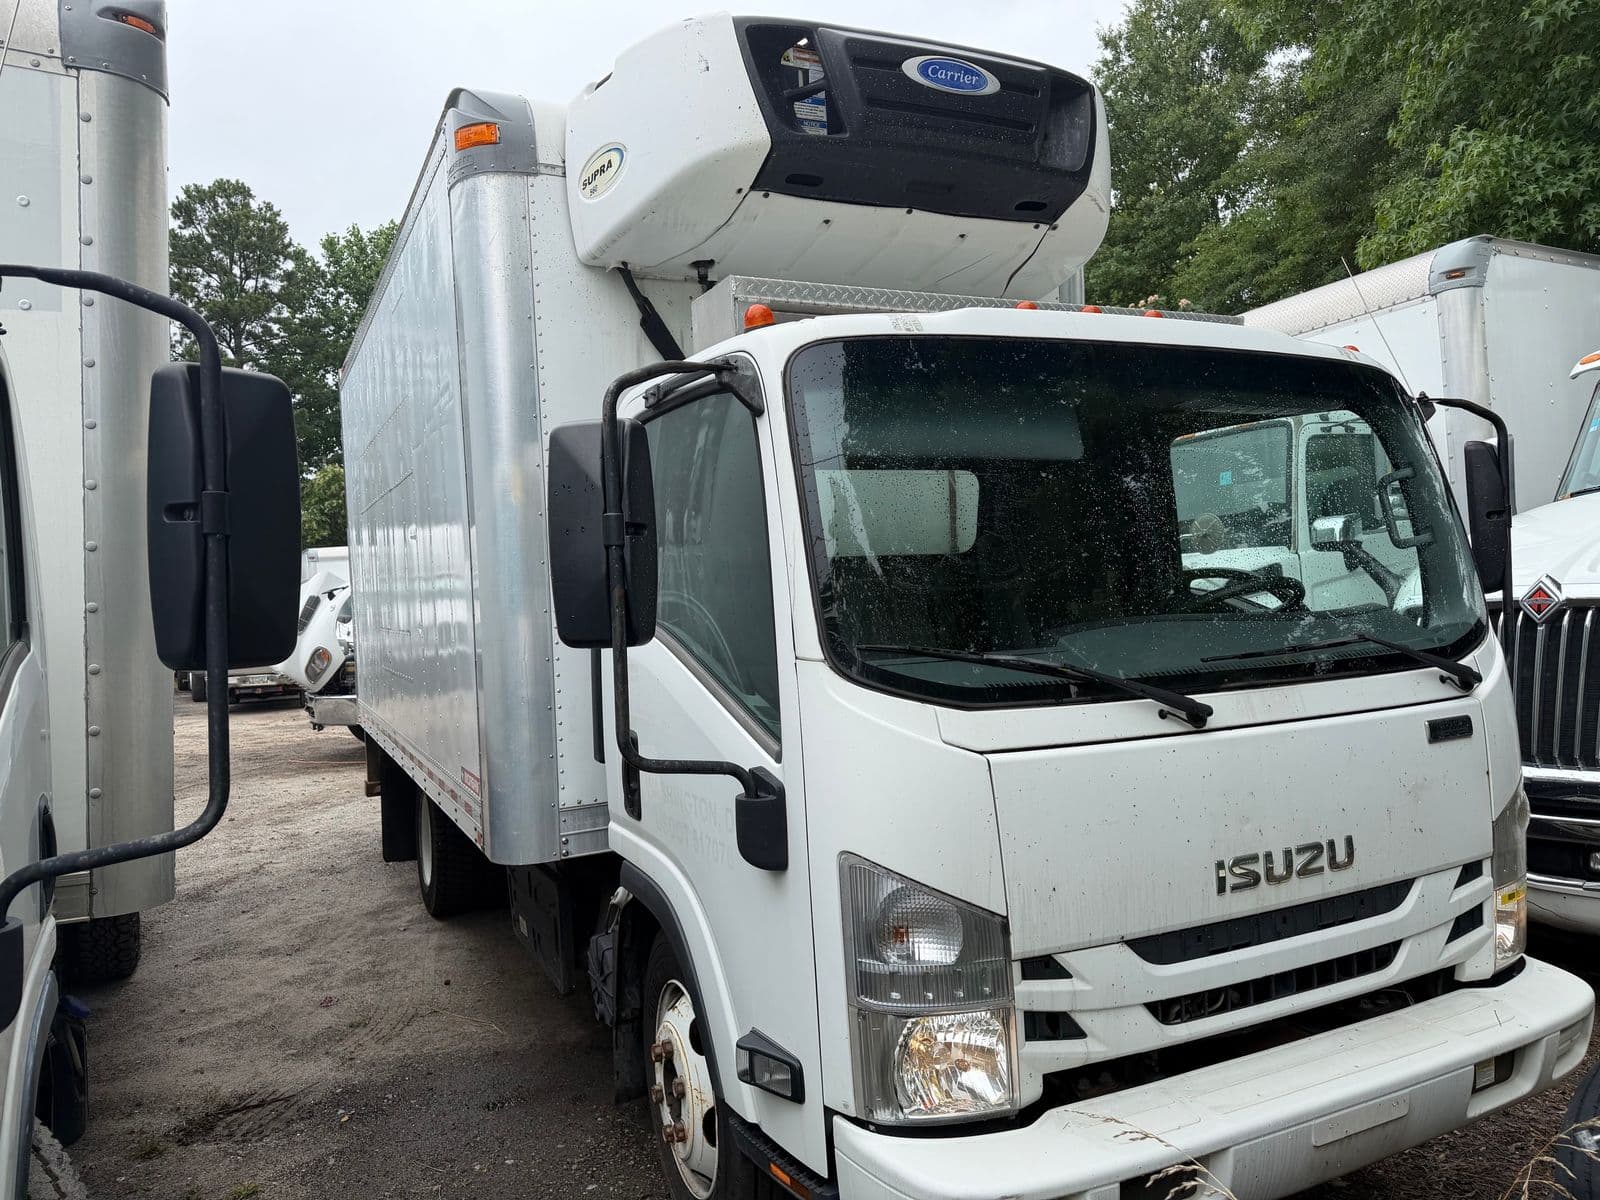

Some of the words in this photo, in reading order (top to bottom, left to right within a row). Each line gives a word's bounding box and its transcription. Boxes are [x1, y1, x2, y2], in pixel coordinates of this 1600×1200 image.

[928, 65, 979, 85] Carrier
[582, 158, 613, 191] SUPRA
[1214, 834, 1356, 896] ISUZU
